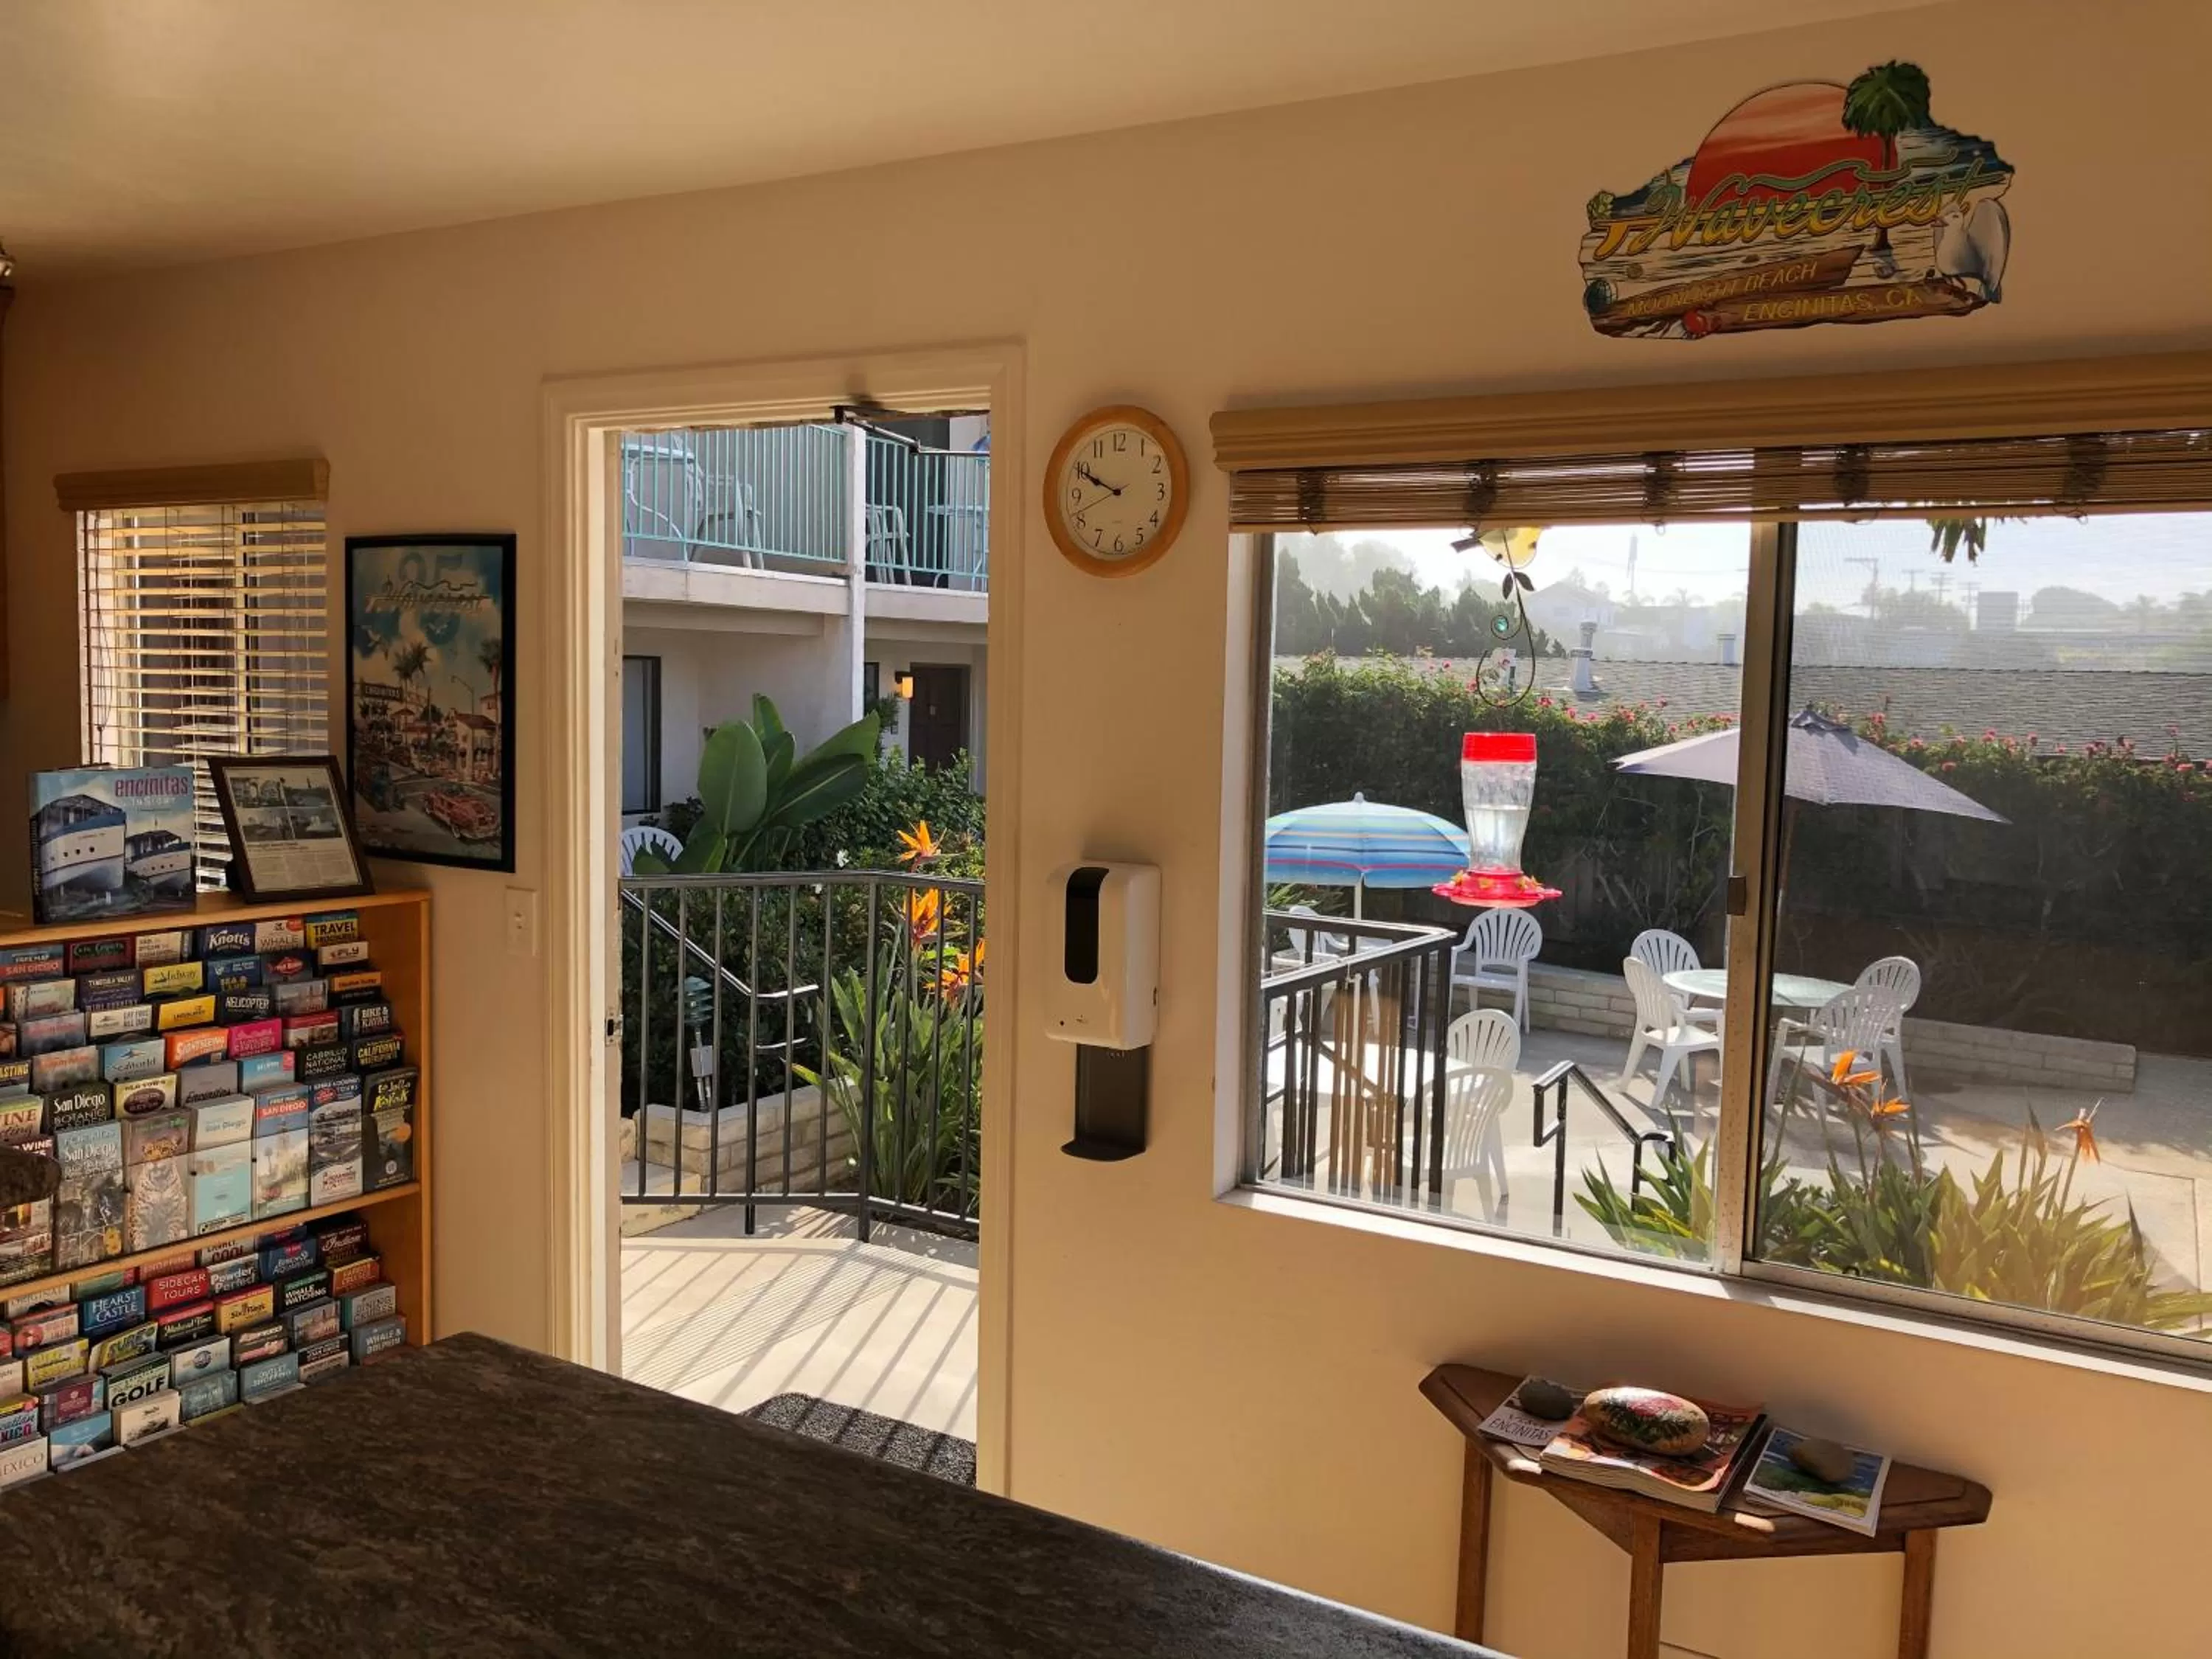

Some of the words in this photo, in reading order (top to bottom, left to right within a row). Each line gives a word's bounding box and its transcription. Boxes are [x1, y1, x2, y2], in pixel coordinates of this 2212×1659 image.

[1593, 158, 2007, 260] Wavecrest
[1743, 259, 1819, 295] BEACH
[1742, 288, 1879, 322] ENCINITAS,
[1884, 287, 1923, 308] CA
[1094, 440, 1103, 459] 11
[1113, 434, 1126, 452] 12
[1141, 439, 1145, 457] 1
[1077, 462, 1091, 480] 10
[1151, 455, 1161, 474] 2
[1071, 488, 1082, 506] 9
[1157, 483, 1165, 501] 3
[1075, 513, 1086, 531] 8
[1149, 509, 1159, 529] 4
[1094, 528, 1104, 547] 7
[1113, 534, 1124, 553] 6
[1135, 527, 1144, 546] 5
[115, 771, 189, 797] encinitas
[314, 922, 355, 936] TRAVEL
[208, 929, 251, 952] Knott's
[260, 934, 299, 947] WHALE
[54, 1096, 73, 1114] San
[74, 1093, 106, 1111] Diego
[262, 1106, 279, 1117] SAN
[280, 1102, 307, 1114] DIEGO
[0, 1109, 37, 1127] INE
[21, 1138, 53, 1152] WINE
[159, 1273, 207, 1290] SIDECAR
[210, 1266, 256, 1285] Powder
[164, 1285, 201, 1301] TOURS
[215, 1276, 257, 1295] Perfect
[93, 1292, 136, 1312] HEARST
[97, 1302, 138, 1323] CASTLE
[111, 1376, 167, 1408] GOLF
[0, 1453, 45, 1476] EXICO
